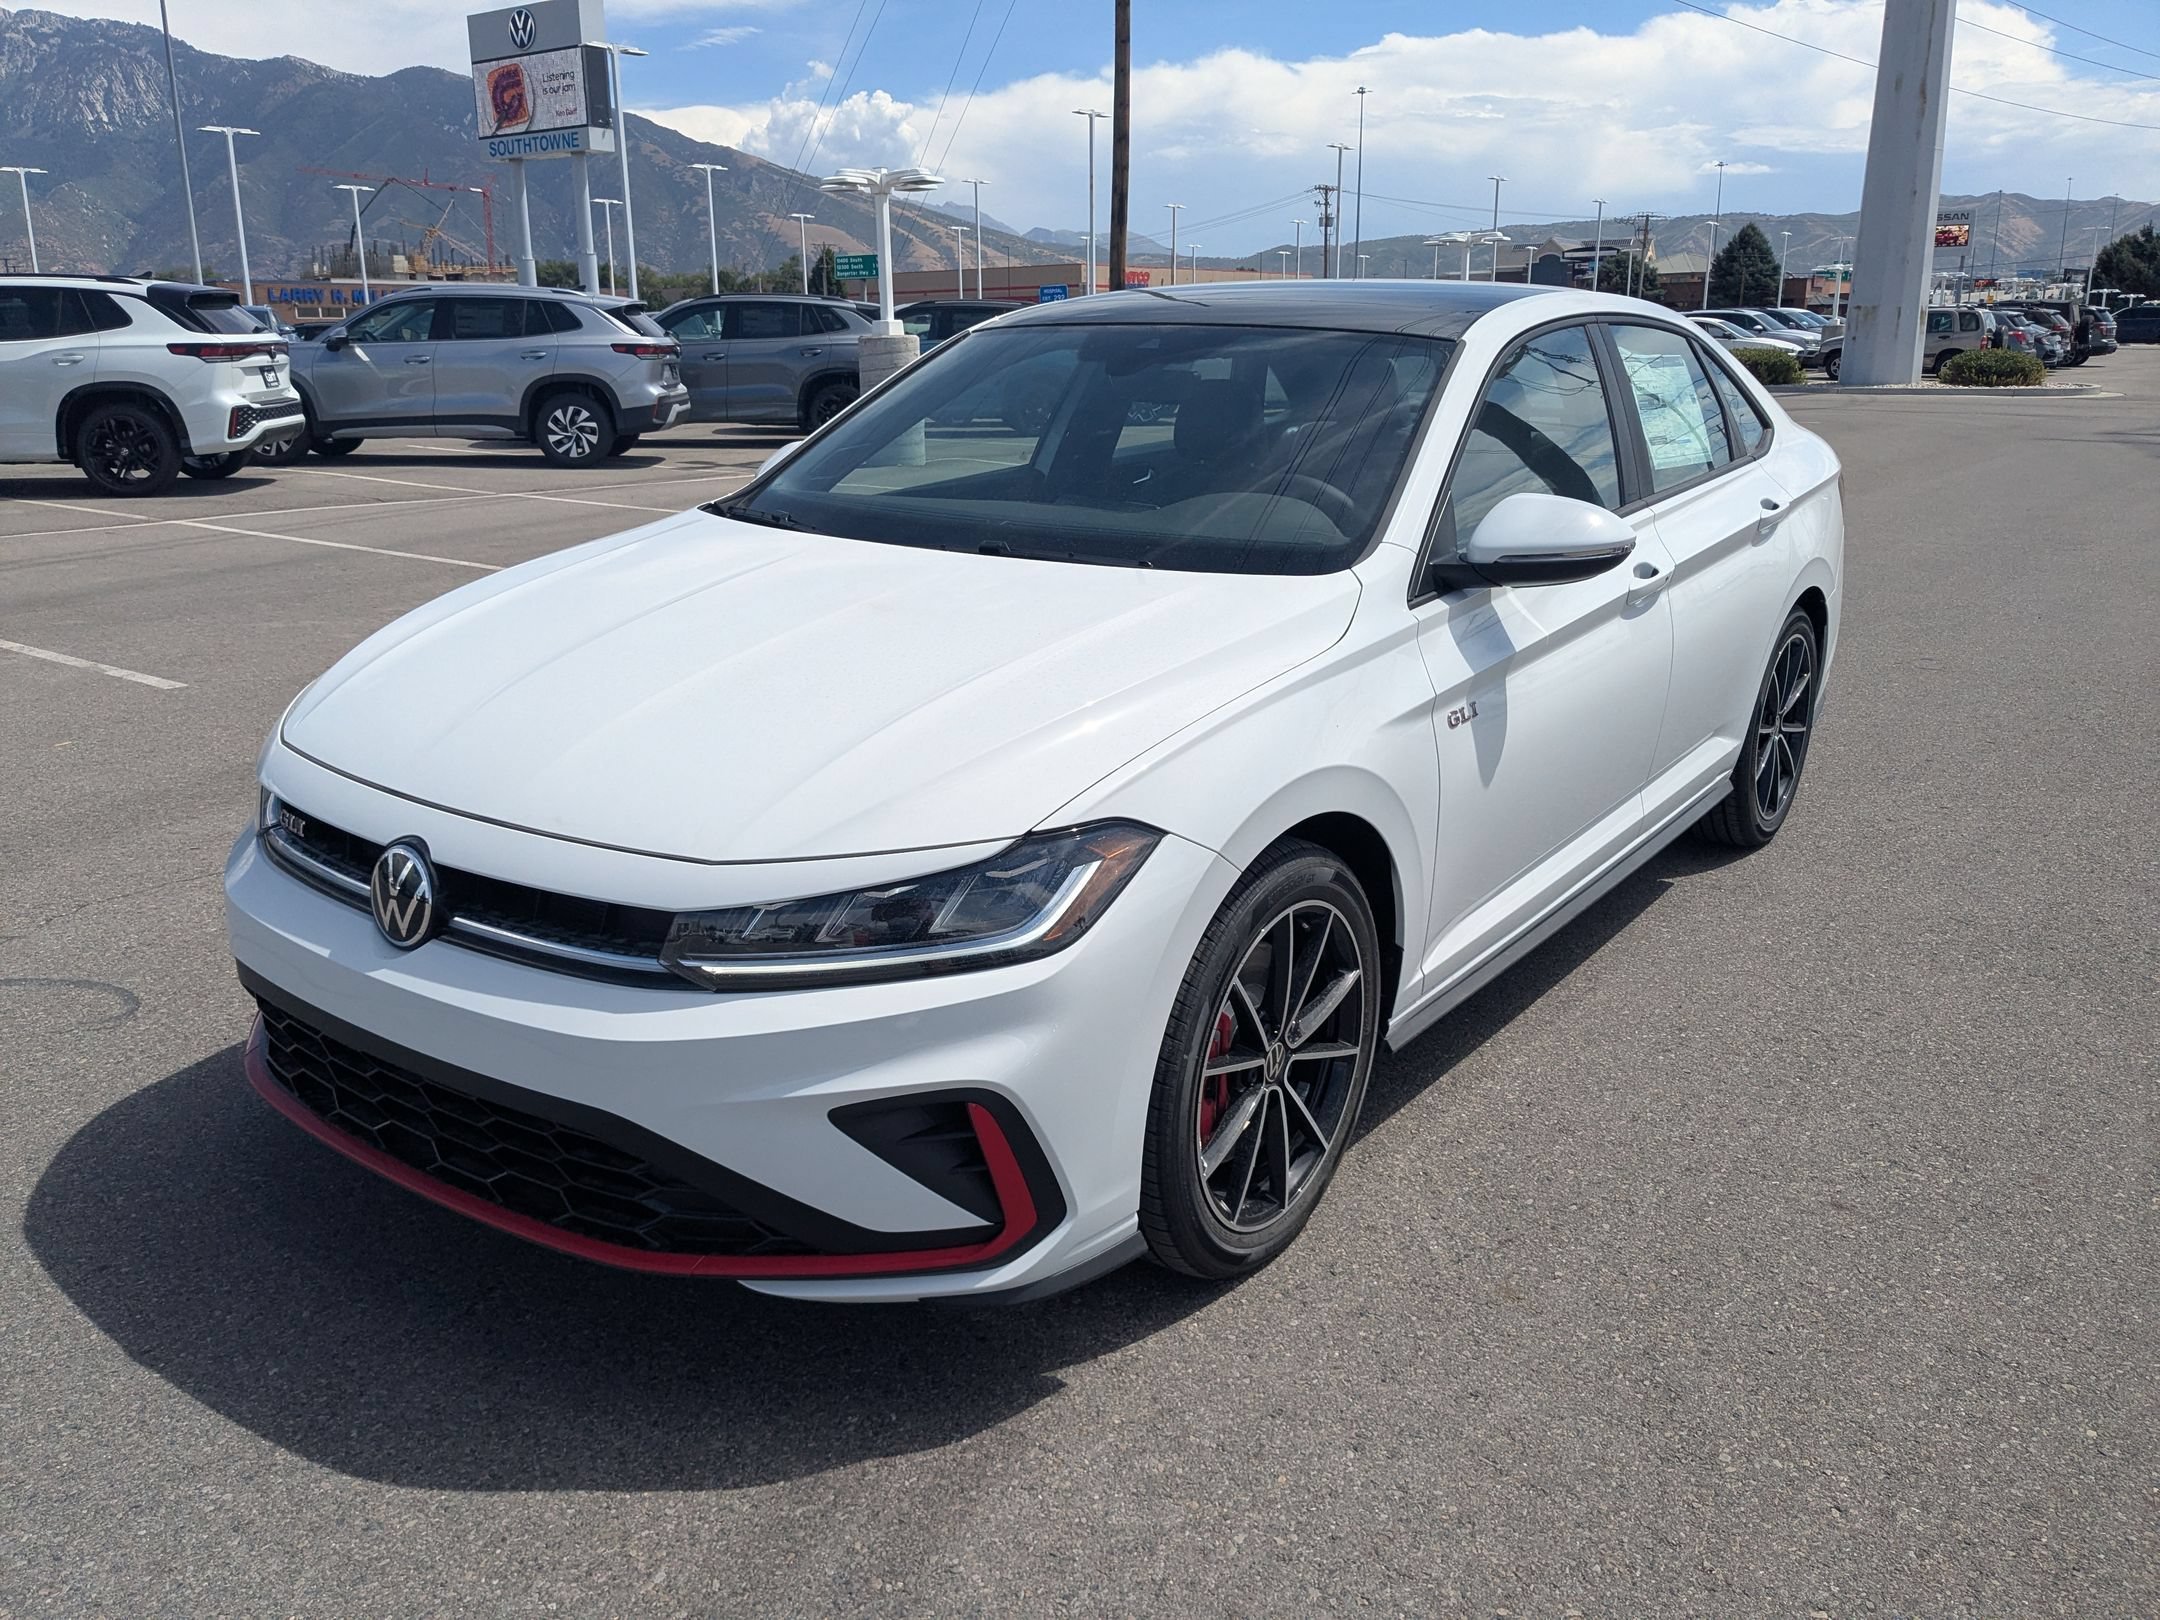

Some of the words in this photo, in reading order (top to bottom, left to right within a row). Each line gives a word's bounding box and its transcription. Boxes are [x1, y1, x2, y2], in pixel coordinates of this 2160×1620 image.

[542, 70, 575, 83] Listening
[489, 131, 580, 157] SOUTHTOWNE
[267, 287, 324, 304] LARRY
[1447, 701, 1479, 730] GLI
[279, 808, 306, 838] GLI
